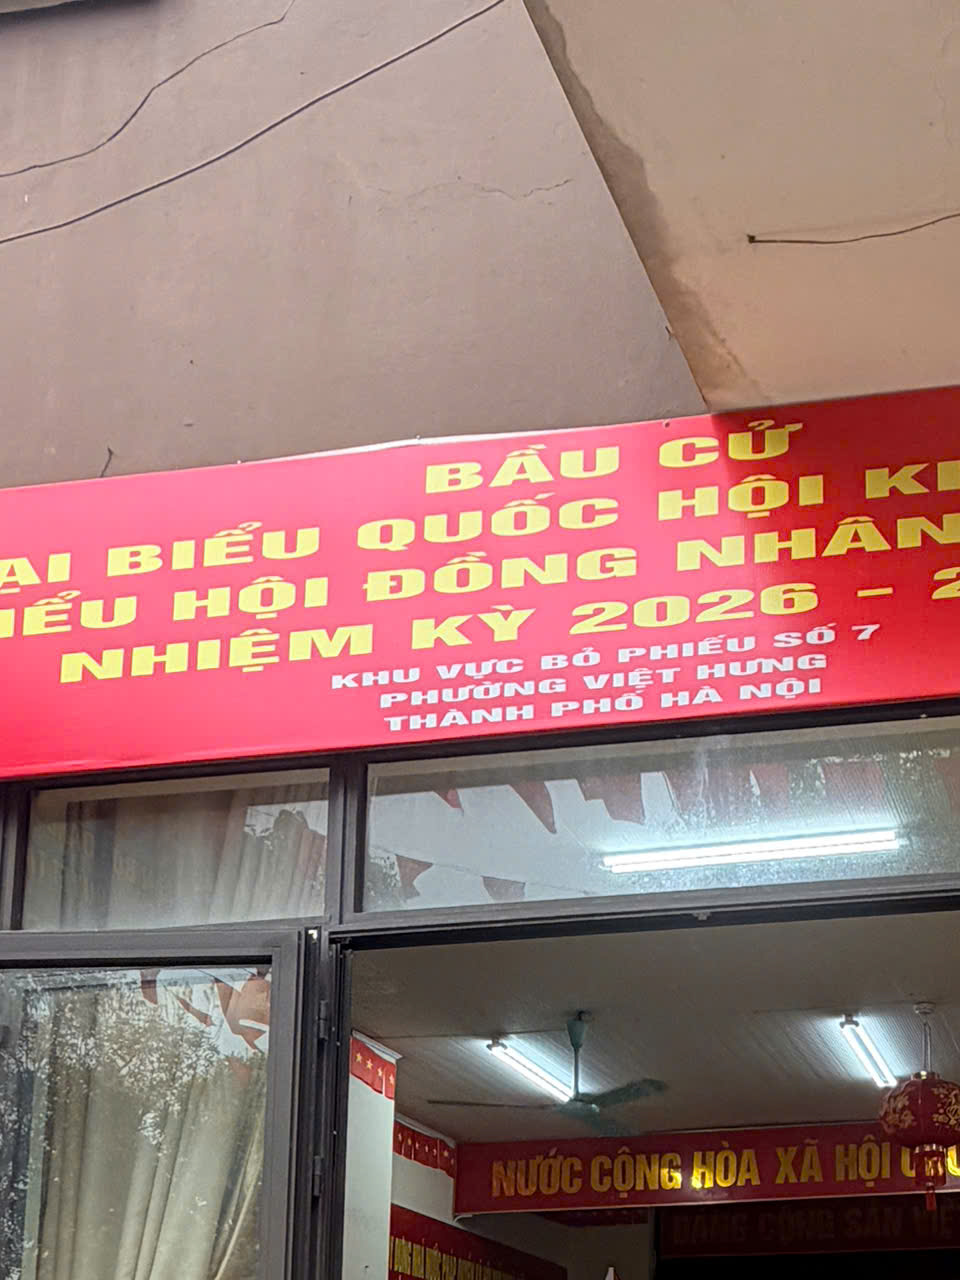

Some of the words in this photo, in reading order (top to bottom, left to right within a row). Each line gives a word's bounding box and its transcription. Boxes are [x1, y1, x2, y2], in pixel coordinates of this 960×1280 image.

[425, 443, 620, 494] BẦU
[658, 419, 803, 468] CỬ
[106, 521, 320, 577] BIỂU
[357, 492, 619, 551] QUỐC
[658, 474, 824, 520] HỘI
[173, 575, 328, 621] HỘI
[362, 547, 637, 602] ĐỒNG
[60, 624, 374, 683] NHIỆM
[411, 604, 537, 650] KỲ
[568, 583, 818, 635] 2026
[331, 667, 420, 689] KHU
[436, 658, 524, 680] VỰC
[540, 647, 601, 671] BỎ
[617, 634, 756, 663] PHIẾU
[773, 622, 837, 648] SỐ
[851, 624, 880, 641] 7
[380, 678, 566, 708] PHƯỜNG
[583, 667, 681, 693] VIỆT
[696, 653, 827, 680] HƯNG
[384, 704, 534, 731] THÀNH
[551, 688, 644, 717] PHỐ
[660, 685, 723, 708] HÀ
[739, 677, 822, 699] NỘI
[491, 1147, 583, 1197] NƯỚC
[590, 1146, 682, 1198] CỘNG
[691, 1140, 761, 1190] HÒA
[775, 1138, 824, 1184] XÃ
[835, 1134, 891, 1187] HỘI
